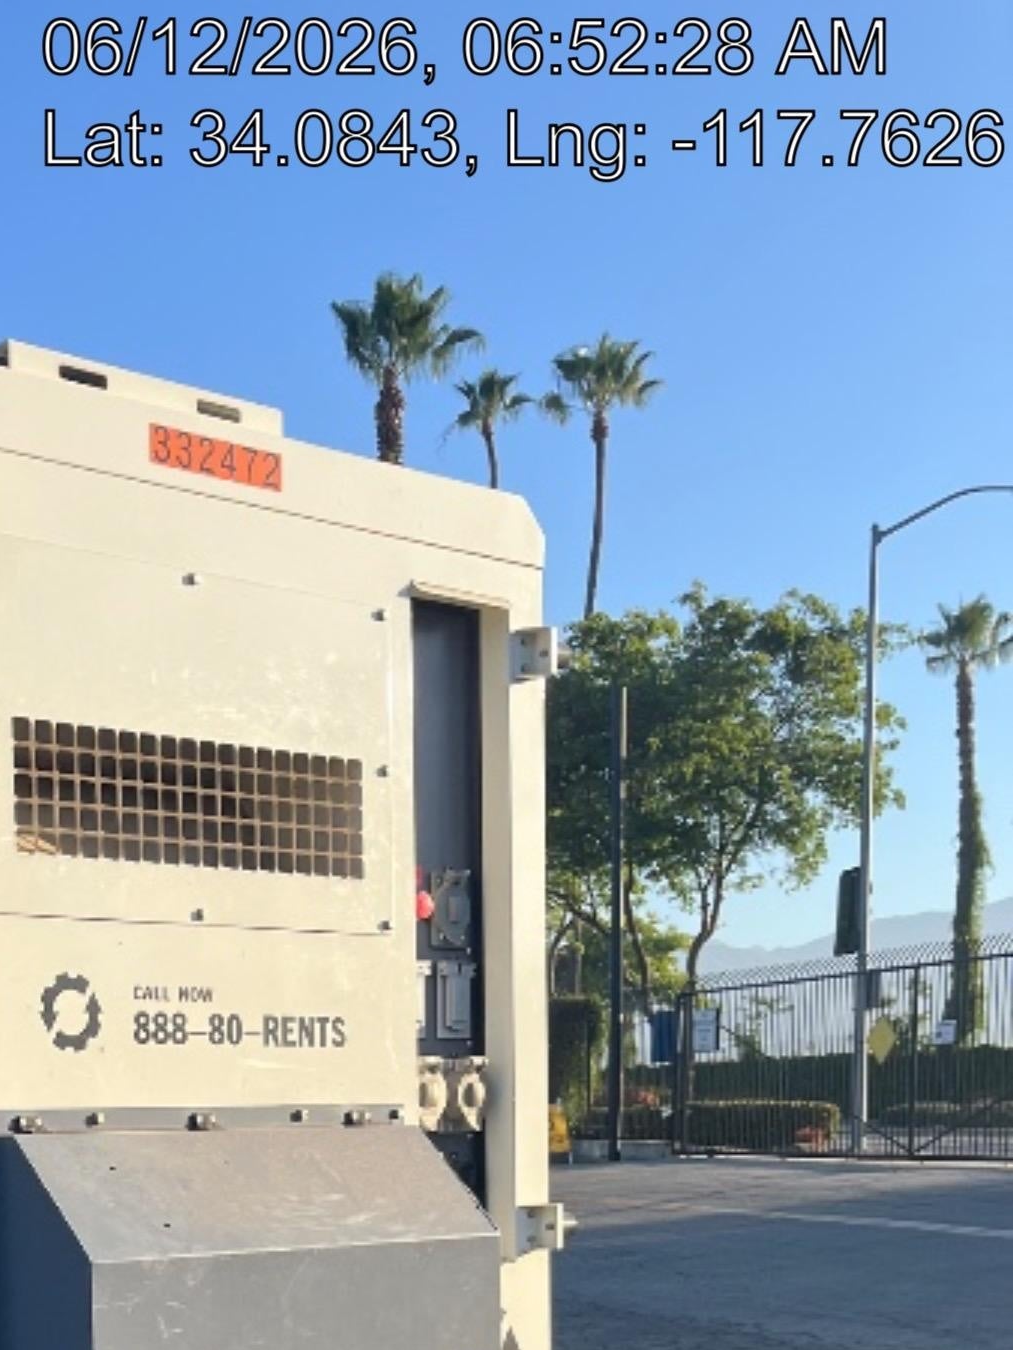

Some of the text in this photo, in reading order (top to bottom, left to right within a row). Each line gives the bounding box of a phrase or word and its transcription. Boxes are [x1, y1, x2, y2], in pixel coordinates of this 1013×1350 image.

[133, 985, 213, 1002] CALL NOW
[133, 1011, 346, 1049] 888-80-RENTS
